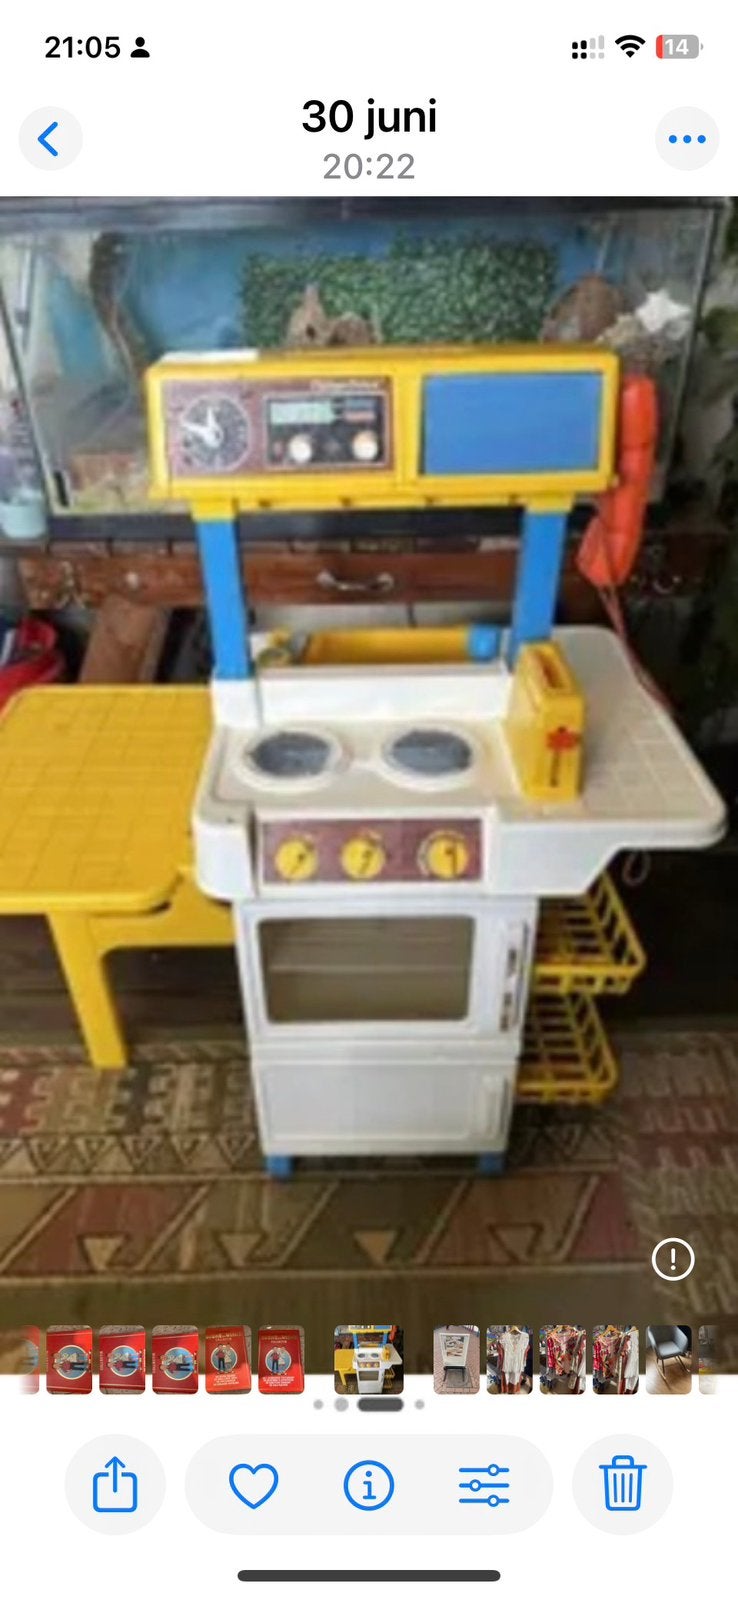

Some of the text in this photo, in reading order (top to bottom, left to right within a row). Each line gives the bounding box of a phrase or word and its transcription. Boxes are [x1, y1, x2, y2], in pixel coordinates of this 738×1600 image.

[44, 35, 121, 59] 21:05
[664, 38, 689, 55] 14
[301, 98, 437, 141] 30 juni
[323, 152, 415, 180] 20:22
